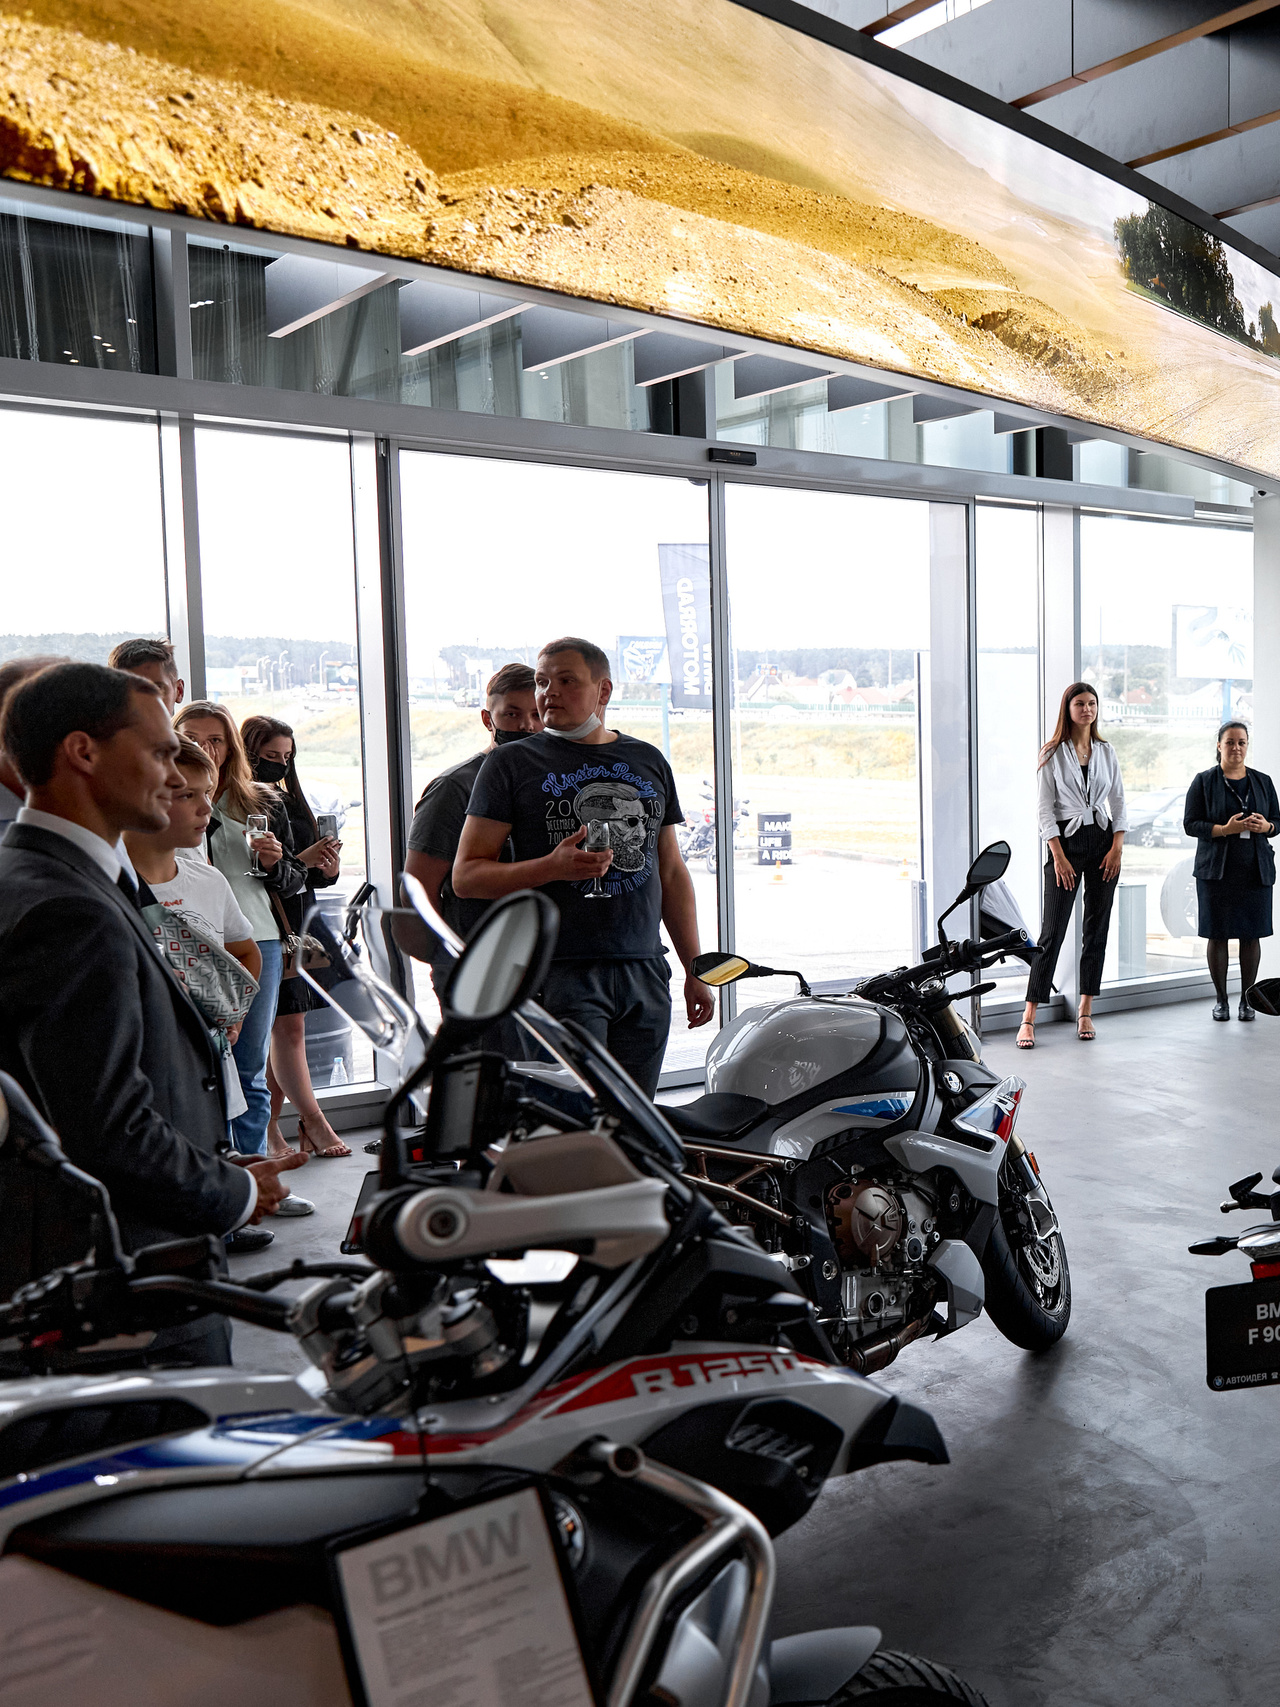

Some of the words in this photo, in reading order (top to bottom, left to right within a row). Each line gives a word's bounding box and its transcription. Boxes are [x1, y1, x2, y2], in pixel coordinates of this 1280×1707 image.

[541, 763, 611, 797] Hipster
[611, 762, 658, 798] Party
[545, 799, 572, 819] 20
[647, 799, 662, 818] 19
[546, 818, 576, 831] DECEMBER
[764, 821, 791, 832] MAK
[760, 836, 782, 848] LIFE
[762, 850, 771, 860] A
[1248, 1328, 1259, 1345] F
[1225, 1372, 1268, 1385] АВТОИДЕЯ
[367, 1511, 521, 1606] BMW
